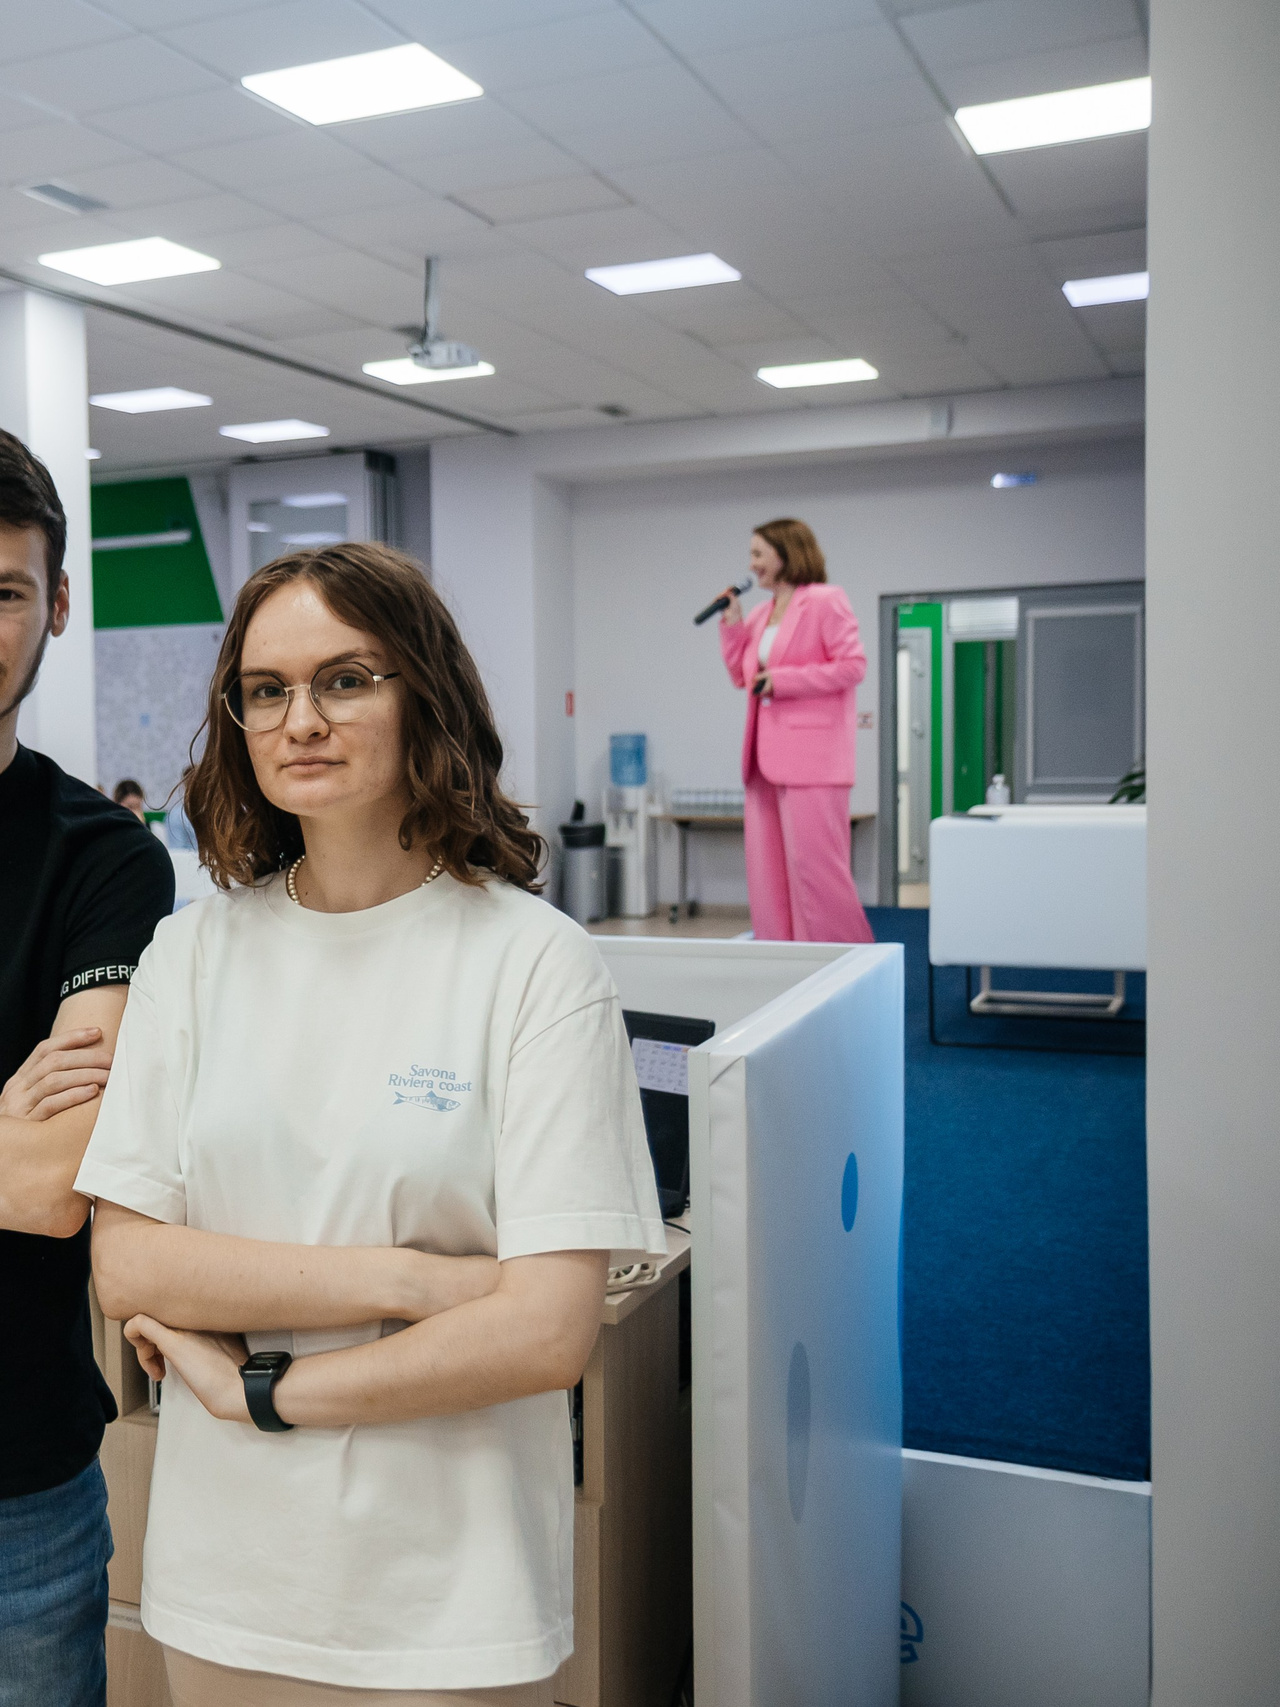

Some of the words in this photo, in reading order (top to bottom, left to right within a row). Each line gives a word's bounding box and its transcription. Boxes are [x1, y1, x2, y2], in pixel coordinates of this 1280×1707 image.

[409, 1064, 456, 1080] Savona
[388, 1073, 434, 1089] Riviera
[439, 1080, 472, 1092] coast
